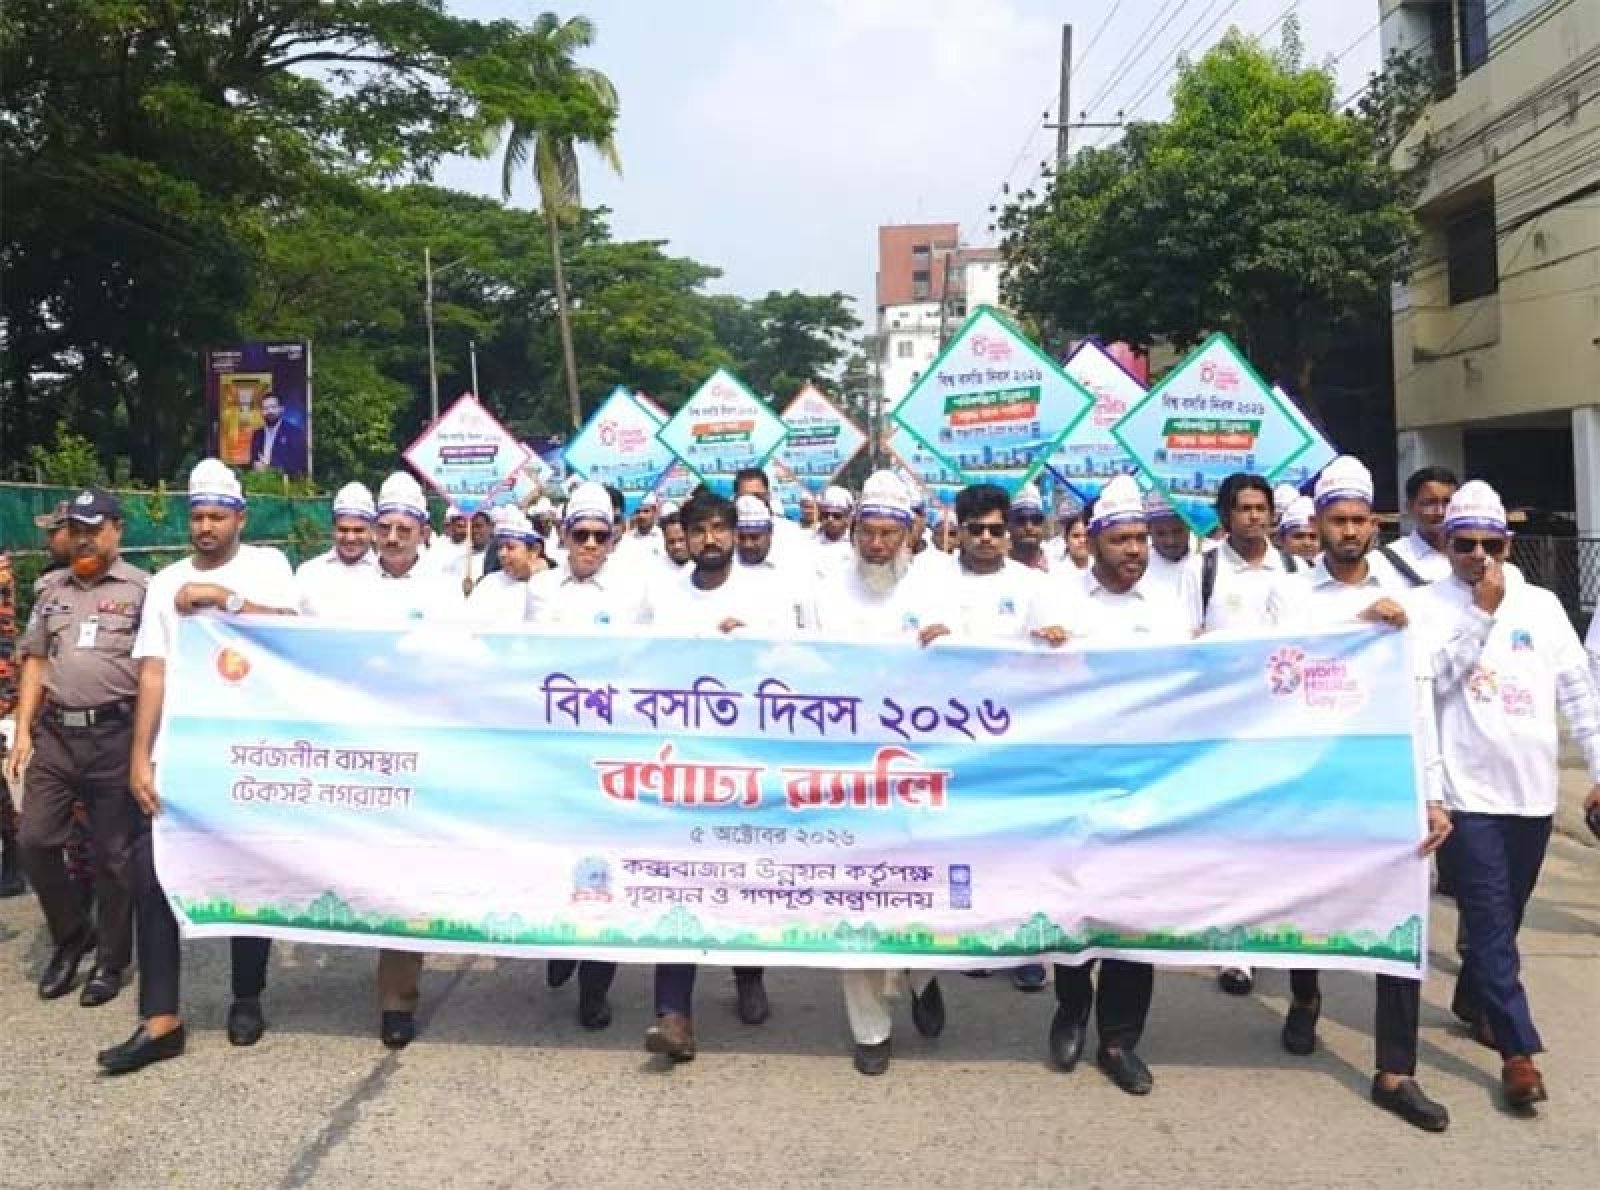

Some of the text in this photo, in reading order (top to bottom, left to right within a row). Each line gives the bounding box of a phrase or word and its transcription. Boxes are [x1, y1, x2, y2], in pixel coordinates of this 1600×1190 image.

[540, 671, 1010, 740] বিশ্ব বসতি দিবস ২০২৬
[231, 739, 419, 776] সর্বজনীন বাসস্থান
[594, 743, 765, 806] বর্ণাঢ্য
[232, 775, 313, 804] টেকসই
[690, 824, 855, 848] ৫ অক্টোবর ২০২৬
[755, 857, 836, 886] উন্নয়ন
[710, 887, 729, 904] ও
[739, 887, 814, 911] গণপূর্ত
